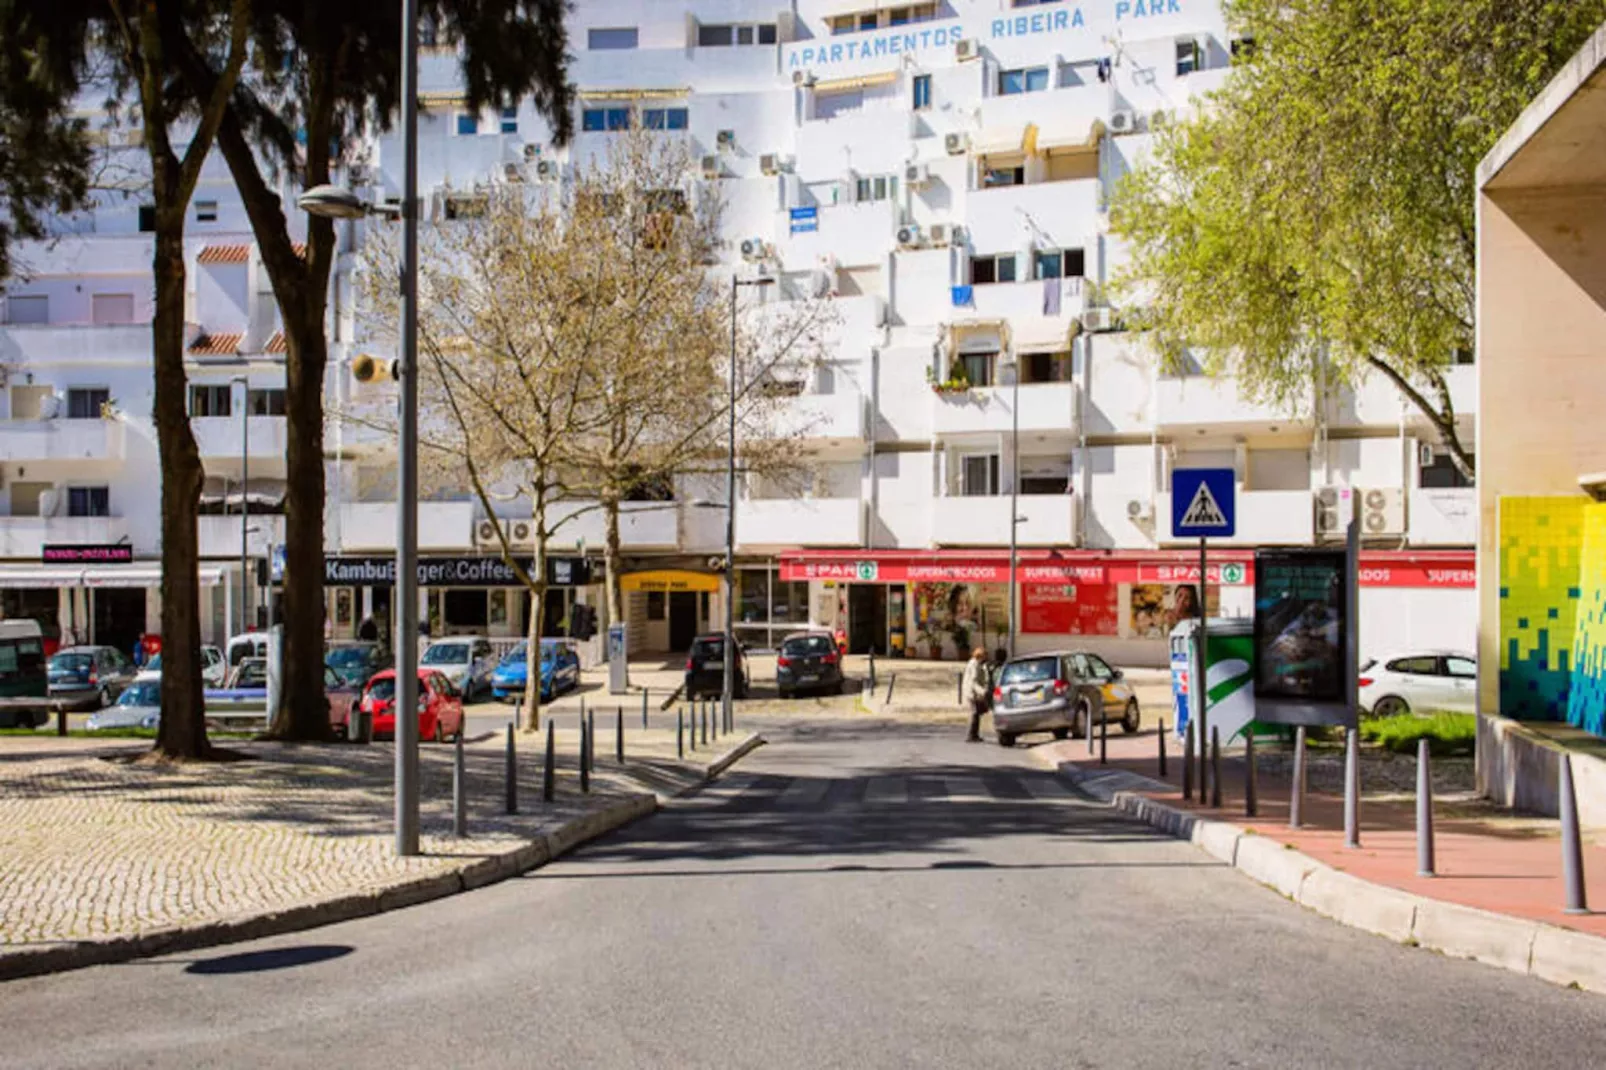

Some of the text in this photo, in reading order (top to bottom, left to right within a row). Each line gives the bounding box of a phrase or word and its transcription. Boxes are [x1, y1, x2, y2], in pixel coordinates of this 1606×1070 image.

[789, 0, 1181, 67] APARTAMENTOS RIBEIRA PARK
[806, 563, 857, 577] SPAR
[1024, 566, 1103, 579] SUPERMARKET
[1158, 565, 1220, 580] SPAR
